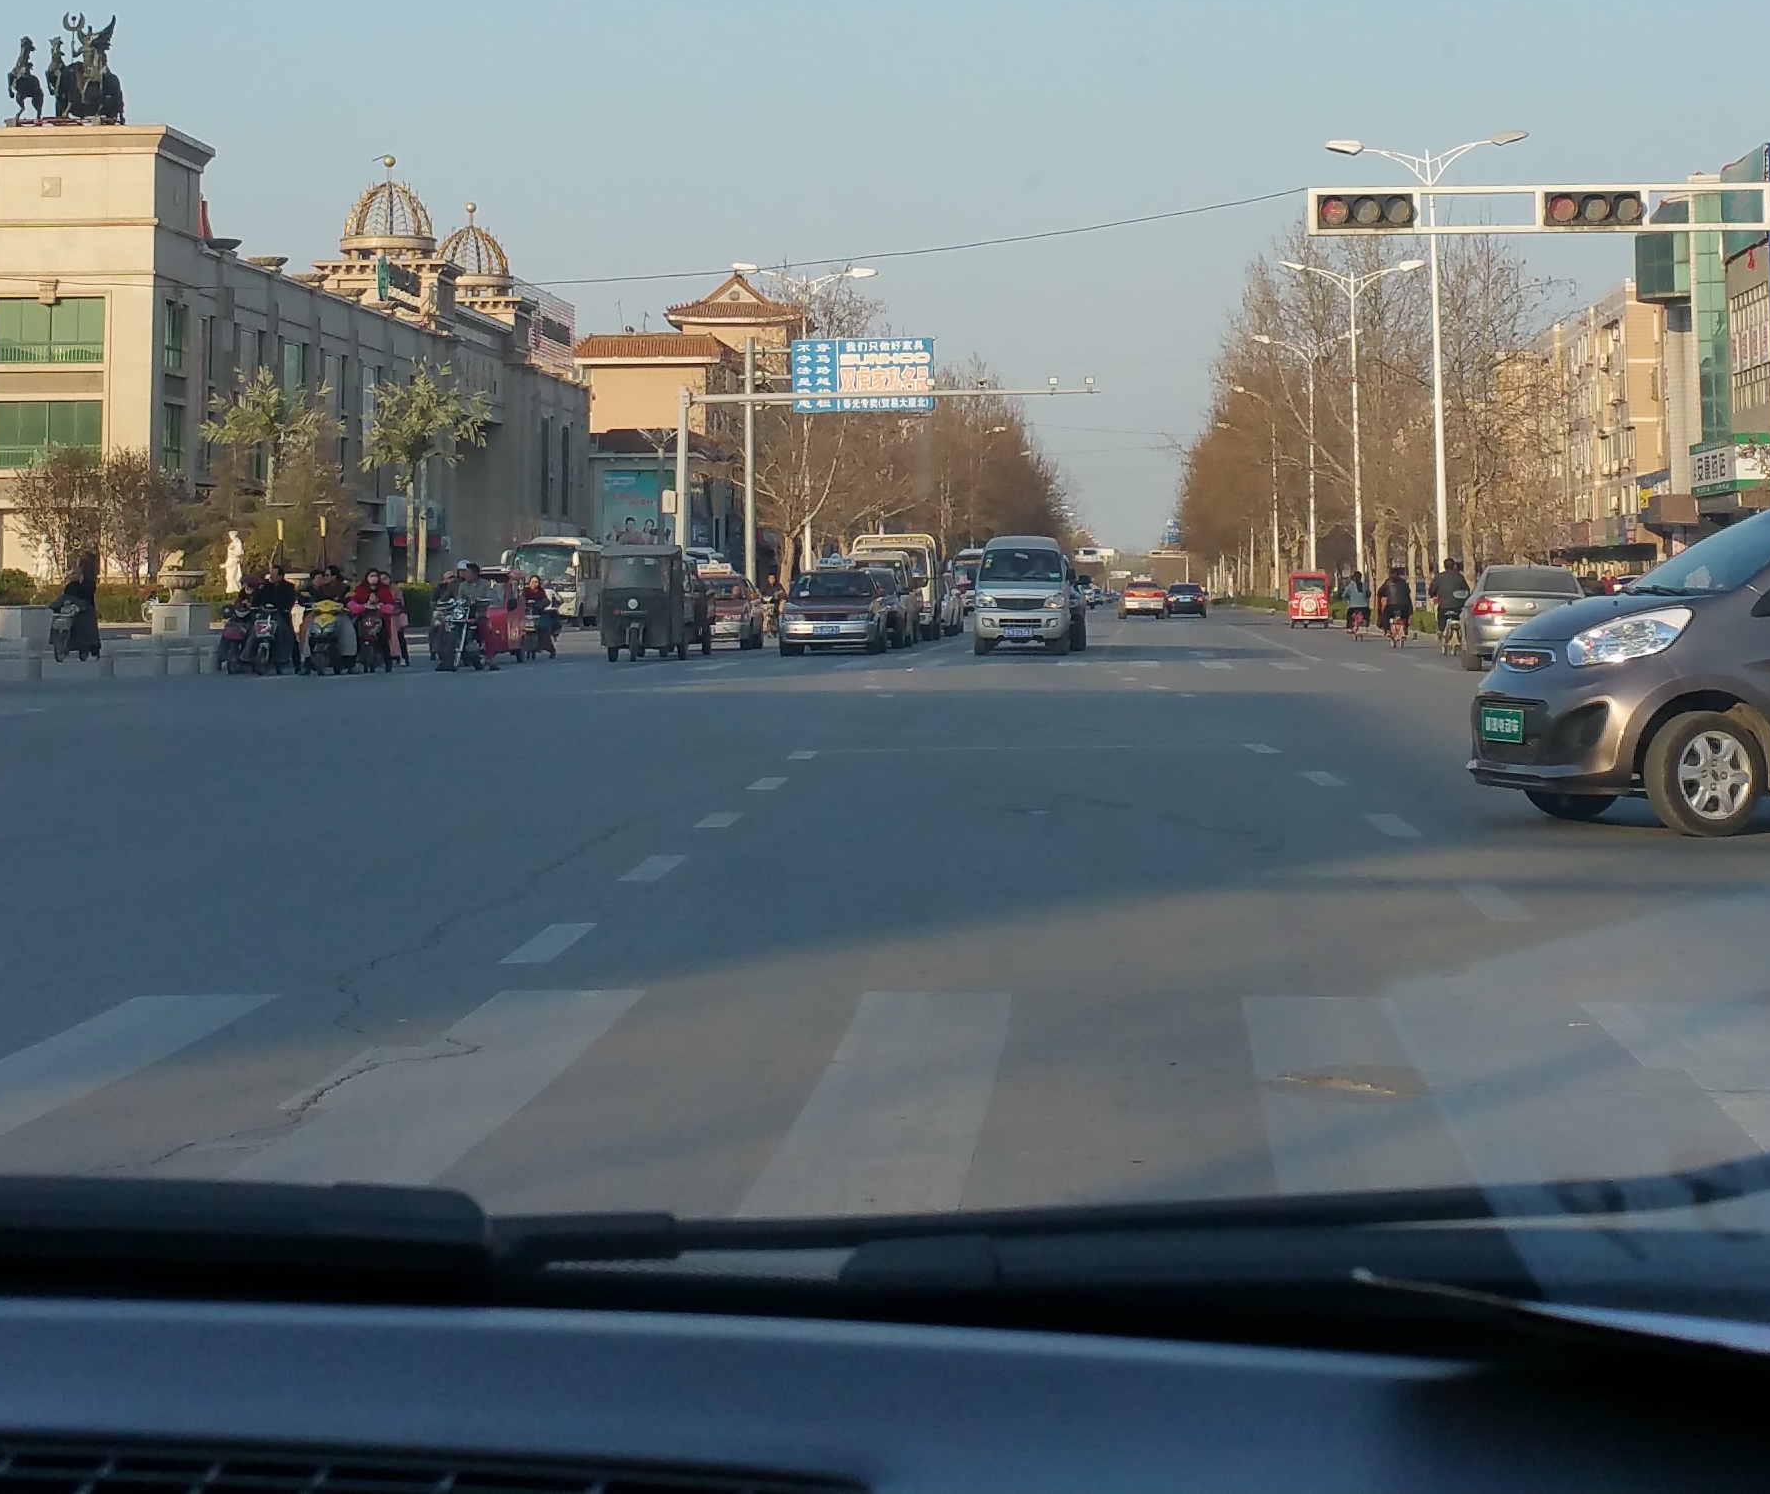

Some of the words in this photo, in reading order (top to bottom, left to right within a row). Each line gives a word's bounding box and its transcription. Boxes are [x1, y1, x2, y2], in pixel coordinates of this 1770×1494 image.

[846, 340, 925, 353] 我们只做好家具
